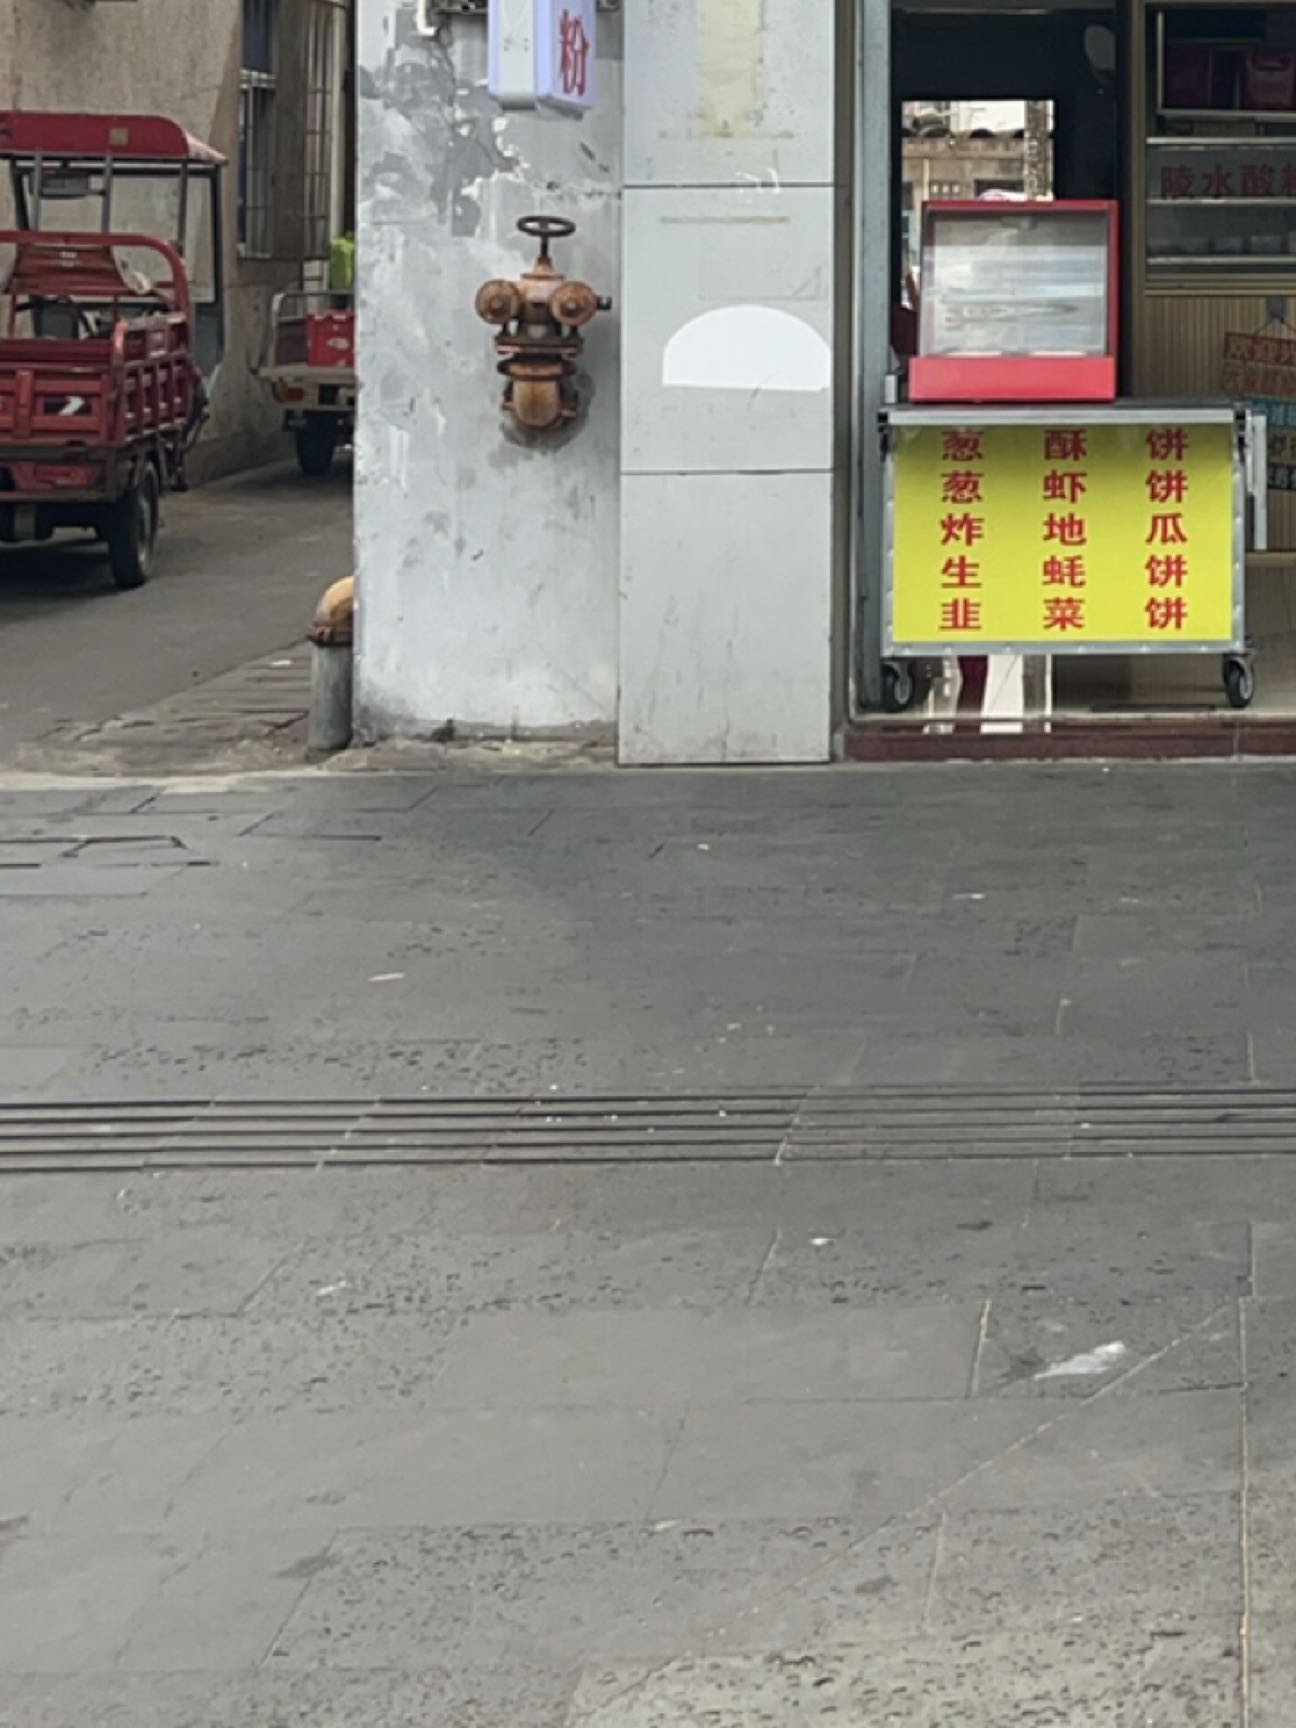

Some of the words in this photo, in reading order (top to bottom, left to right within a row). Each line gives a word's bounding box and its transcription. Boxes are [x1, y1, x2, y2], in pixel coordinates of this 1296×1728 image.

[940, 429, 1188, 462] 葱酥饼
[940, 470, 1188, 504] 葱虾饼
[940, 512, 1188, 547] 炸地瓜
[940, 555, 1188, 589] 生蚝饼
[940, 597, 1188, 631] 韭菜饼
